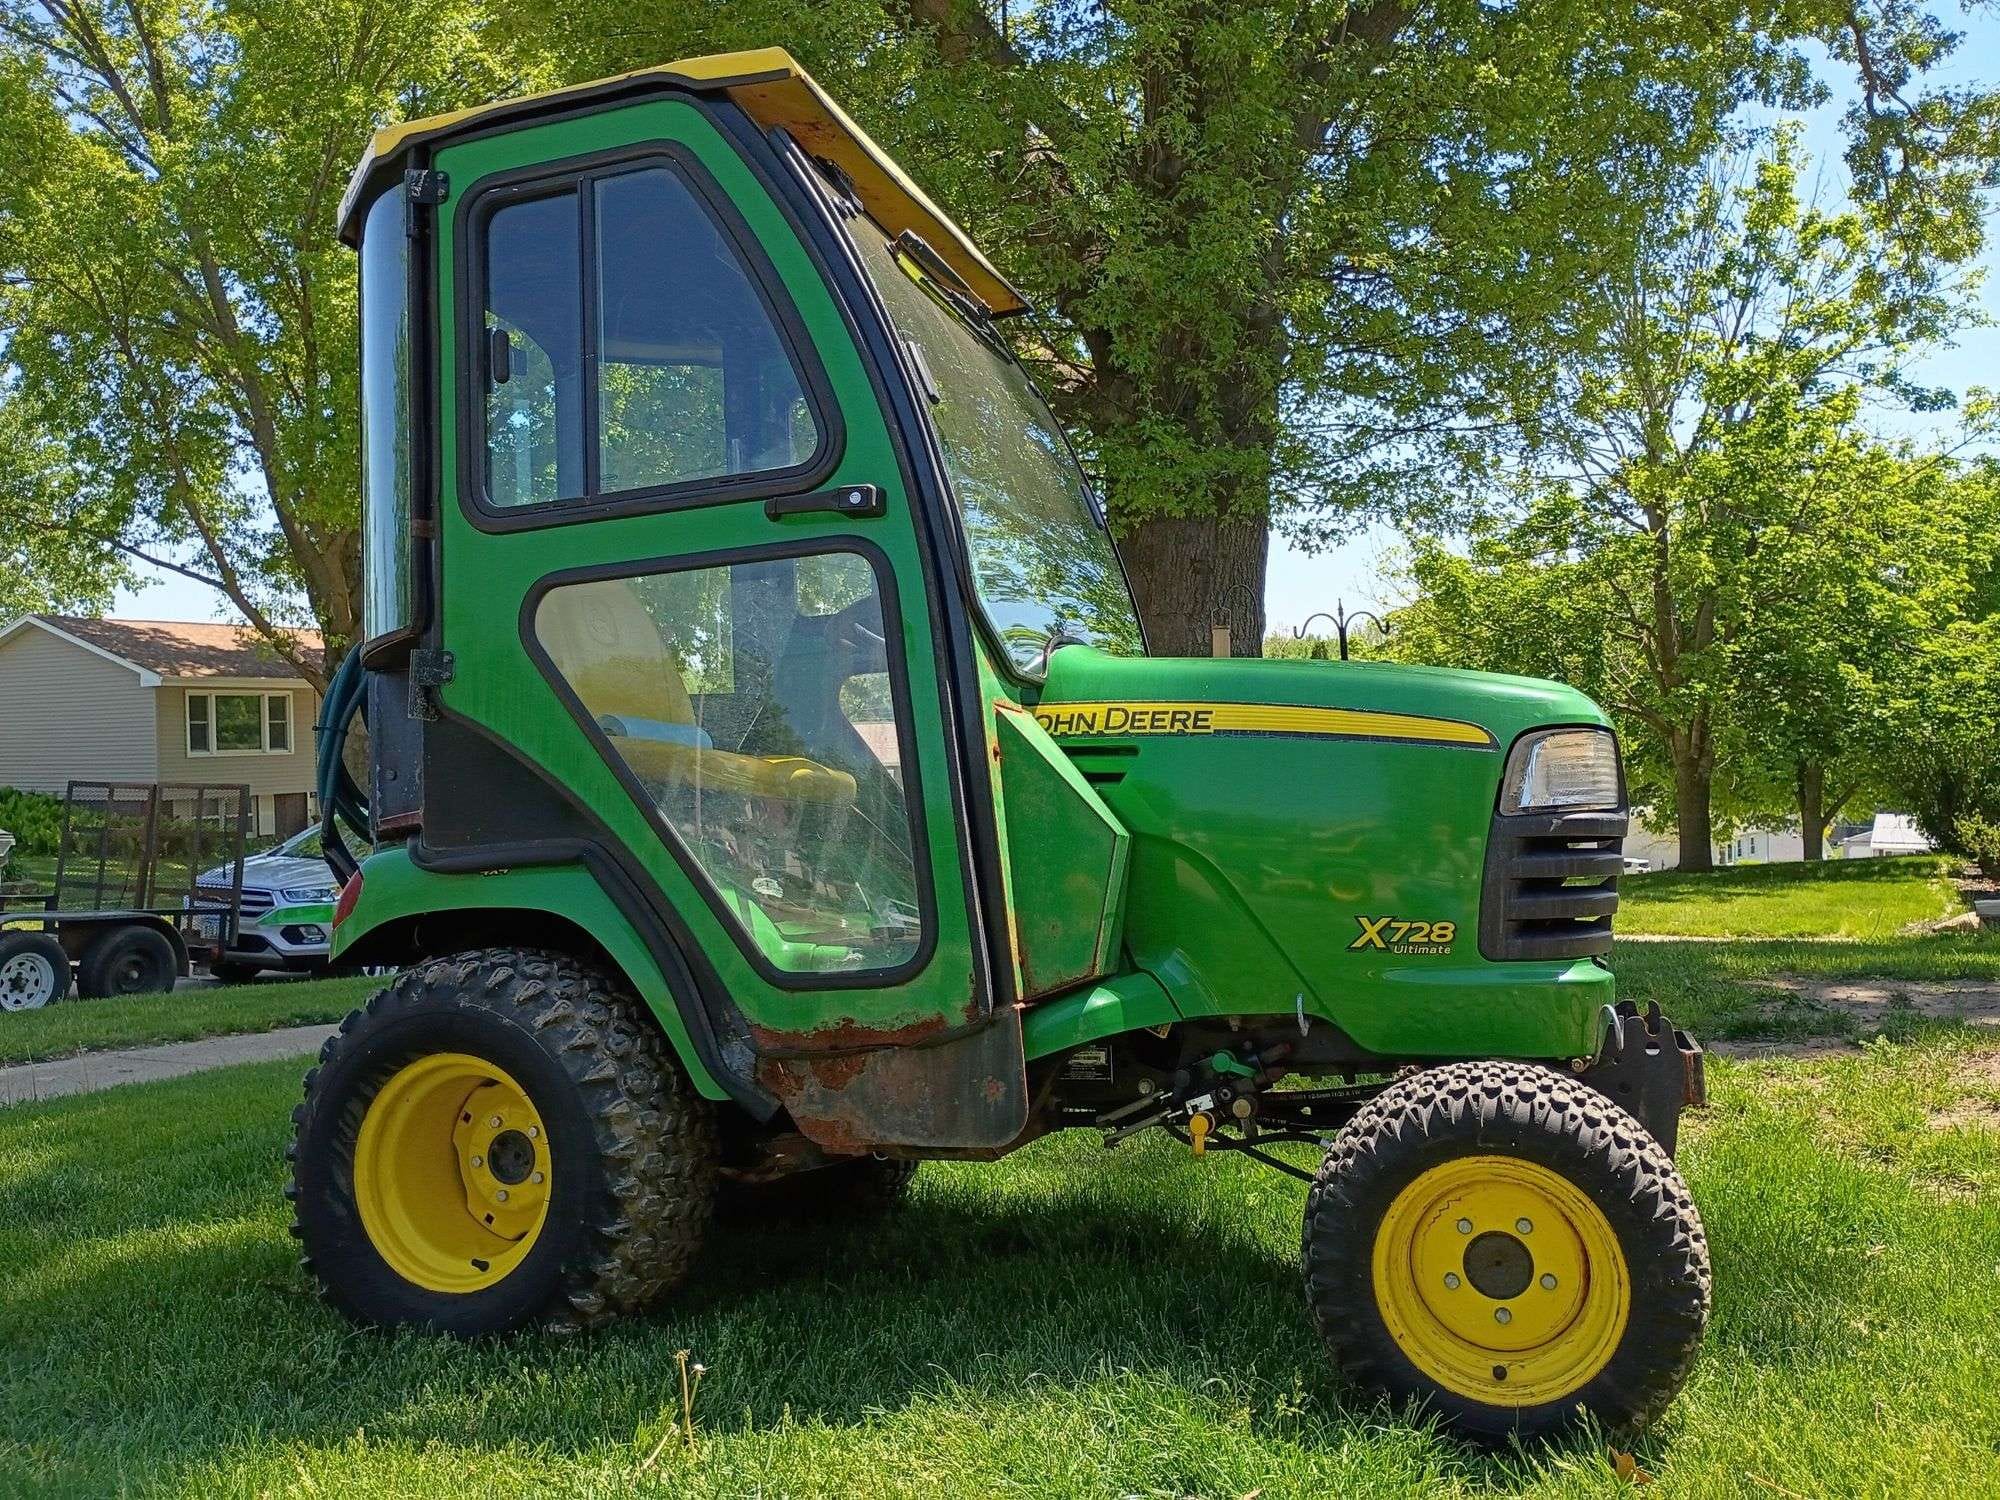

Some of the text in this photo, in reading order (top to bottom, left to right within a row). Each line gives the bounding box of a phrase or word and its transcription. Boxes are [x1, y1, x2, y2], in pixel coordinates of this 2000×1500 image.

[1035, 706, 1215, 733] OHN DEERE
[1348, 915, 1456, 949] X728
[1392, 944, 1452, 955] Ultimate
